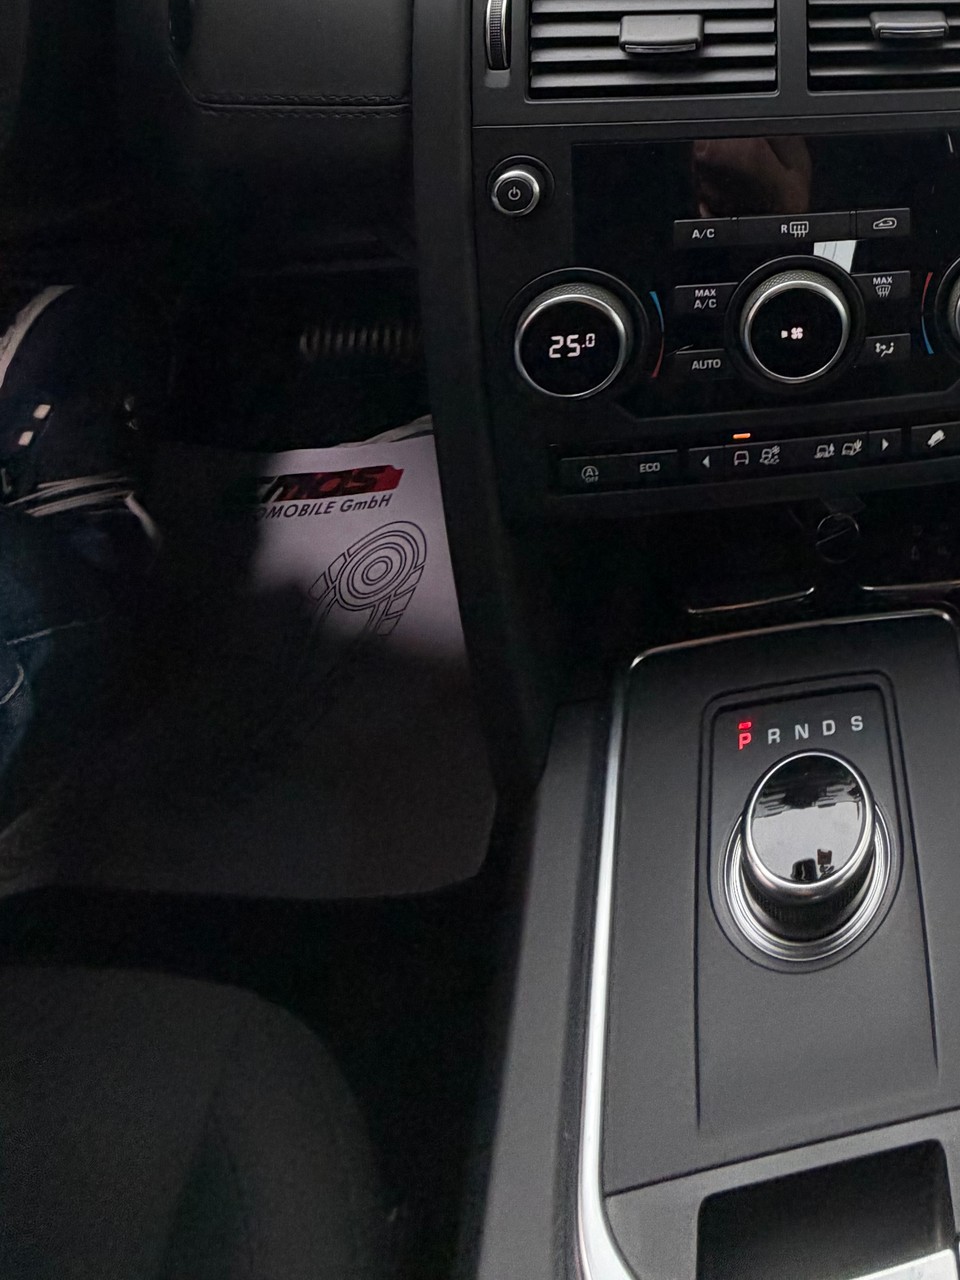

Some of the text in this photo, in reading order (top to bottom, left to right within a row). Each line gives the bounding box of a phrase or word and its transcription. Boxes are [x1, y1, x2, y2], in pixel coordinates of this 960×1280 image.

[691, 227, 716, 241] A/C
[780, 224, 788, 235] R
[872, 276, 894, 285] MAX
[694, 288, 717, 298] MAX
[694, 297, 718, 310] A/C
[548, 332, 596, 358] 25.0
[691, 358, 722, 370] AUTO
[639, 462, 661, 473] ECO
[339, 493, 393, 514] GmbH
[738, 715, 863, 751] P R N D S
